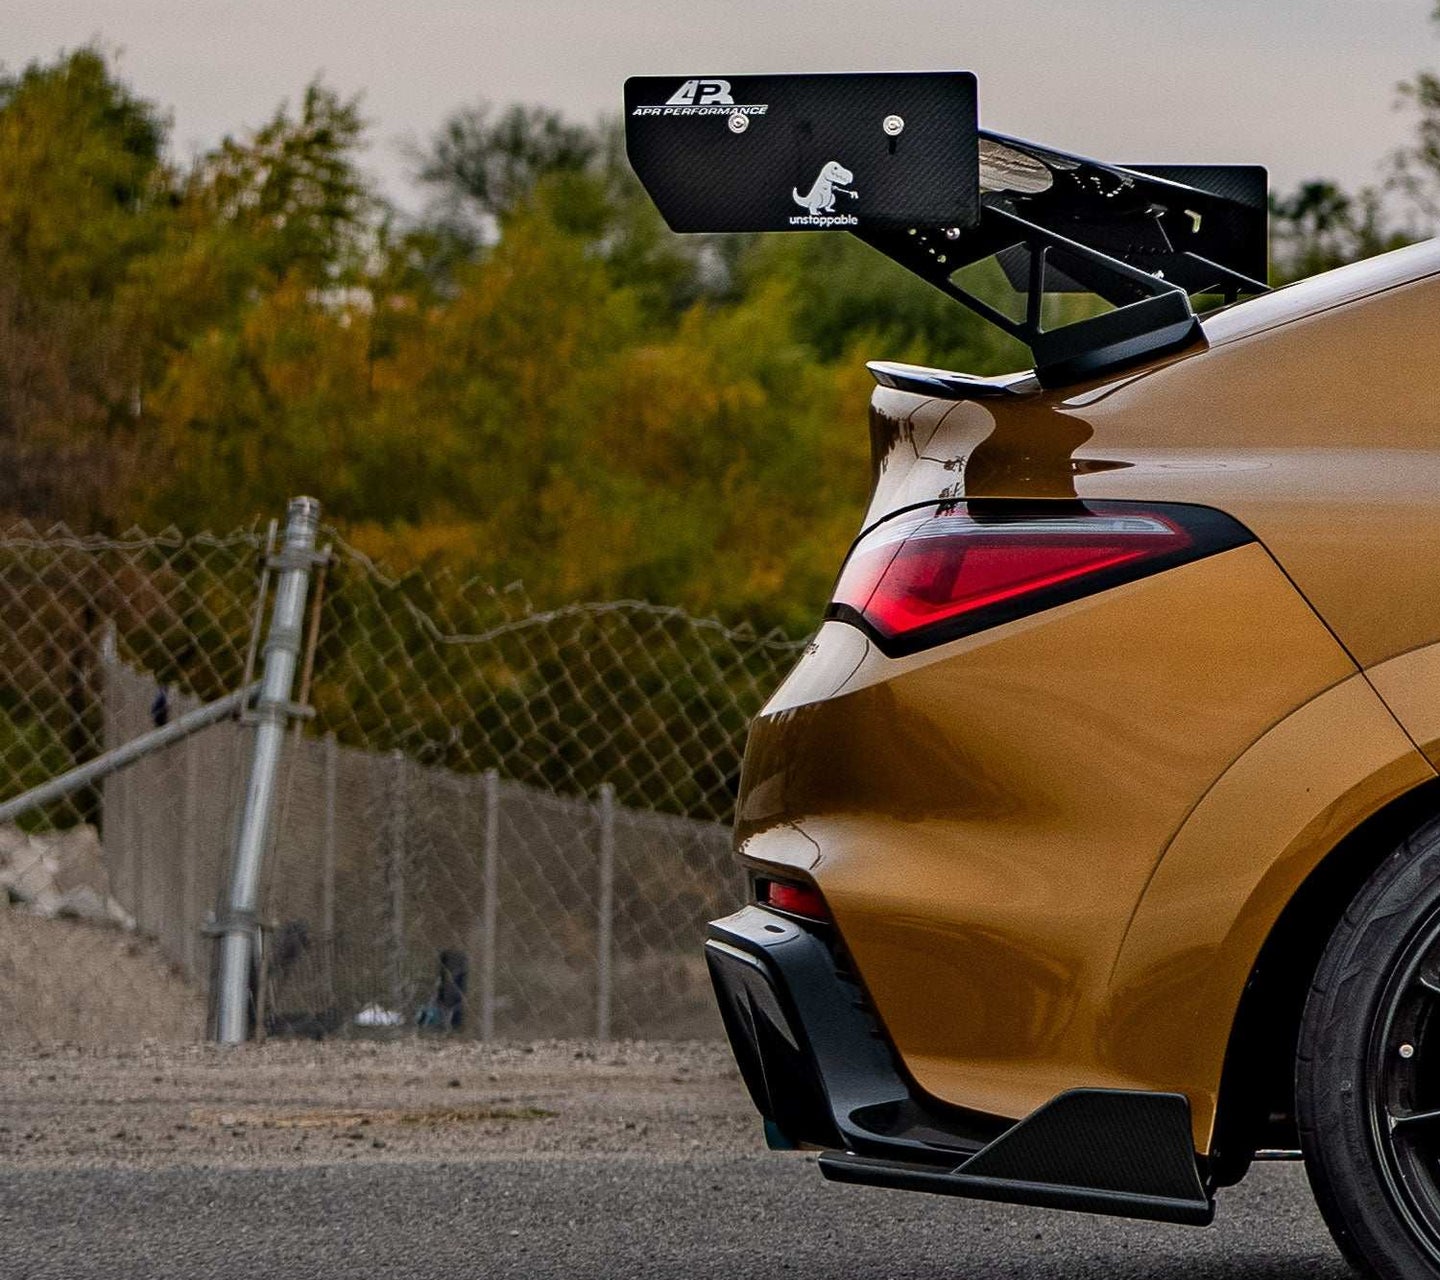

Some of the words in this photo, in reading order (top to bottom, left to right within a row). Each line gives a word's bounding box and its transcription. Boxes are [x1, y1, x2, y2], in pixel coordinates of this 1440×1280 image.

[632, 107, 661, 116] APR
[662, 106, 769, 116] PERFORMANCE
[789, 214, 858, 228] unstoppable
